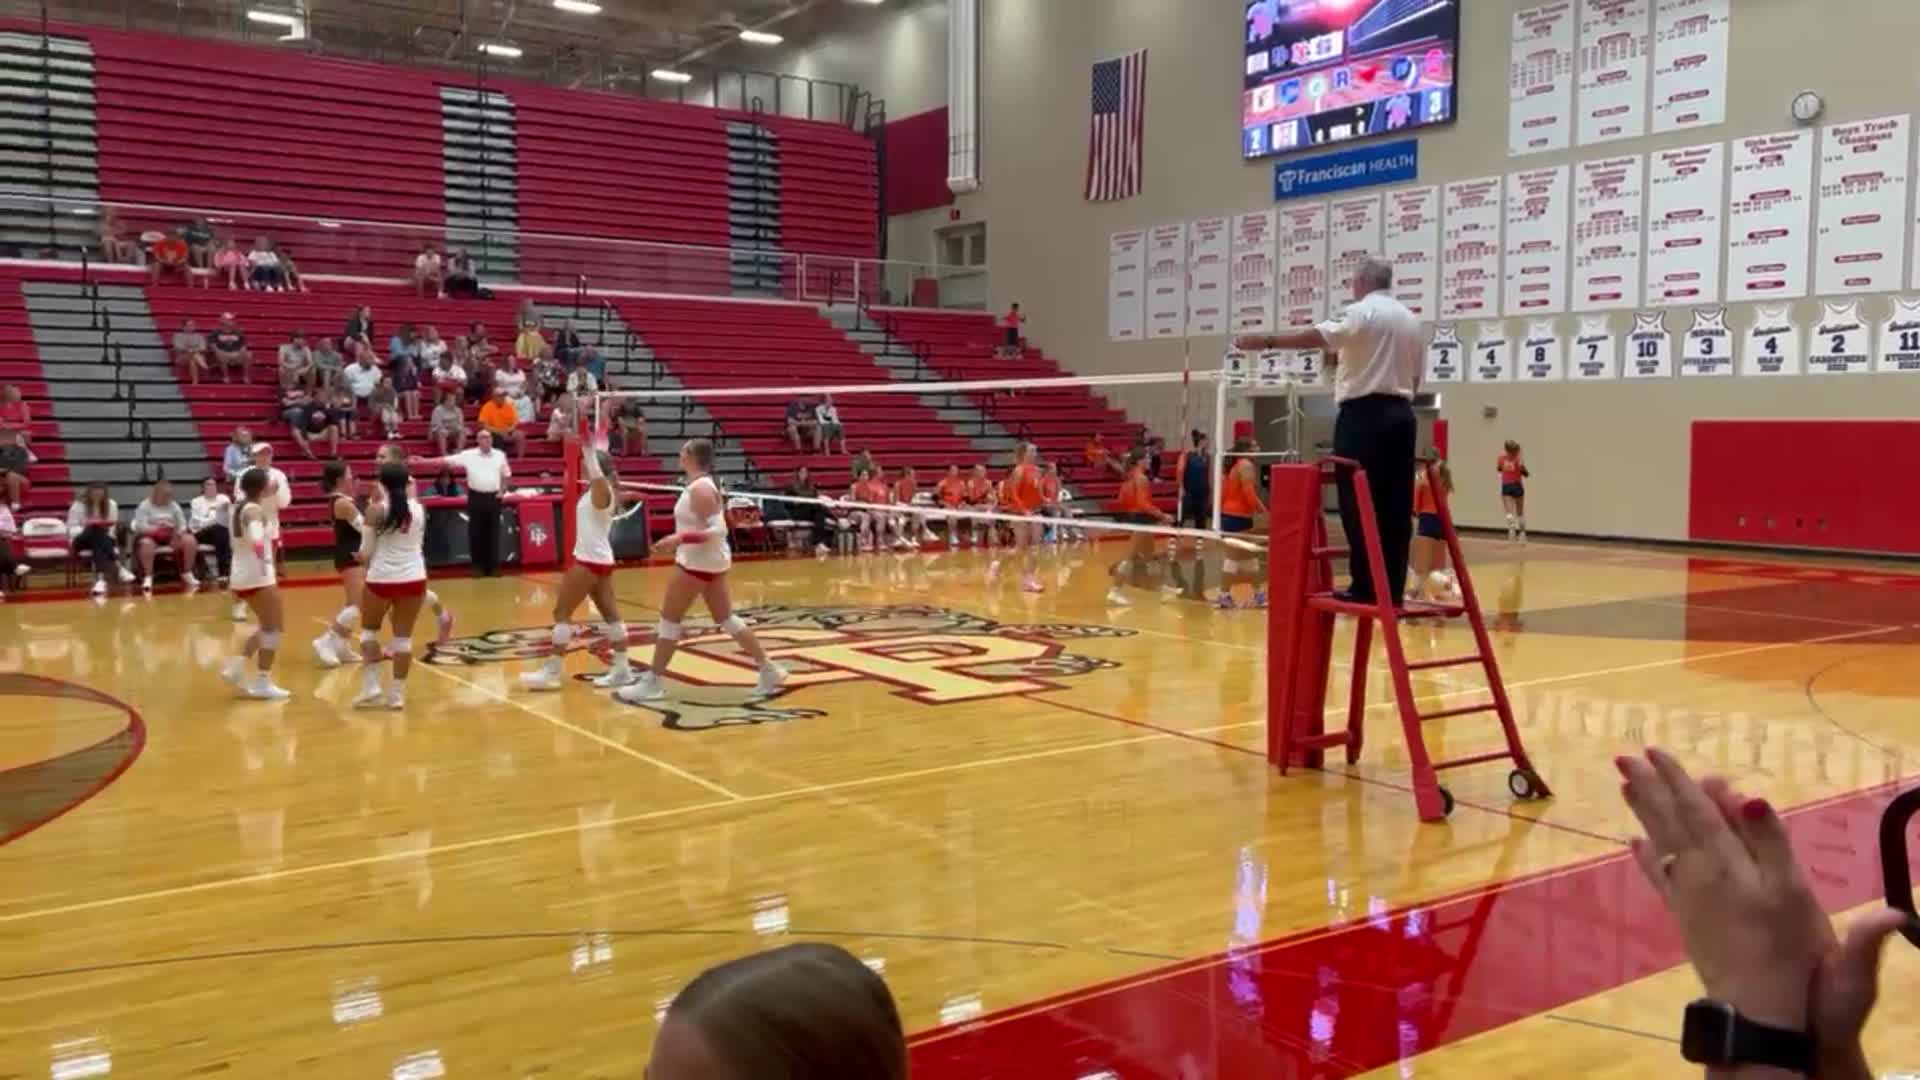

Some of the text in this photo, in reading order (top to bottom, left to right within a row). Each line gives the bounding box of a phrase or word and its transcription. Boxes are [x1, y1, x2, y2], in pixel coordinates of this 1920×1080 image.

[1298, 154, 1414, 185] Franciscan HEALTH
[1700, 338, 1713, 355] 3
[1765, 336, 1778, 354] 4
[1831, 334, 1845, 353] 2
[1899, 331, 1919, 350] 11
[1440, 350, 1449, 364] 2
[1486, 349, 1495, 365] 4
[1534, 346, 1545, 362] 8
[1587, 344, 1598, 361] 7
[1637, 341, 1658, 358] 10
